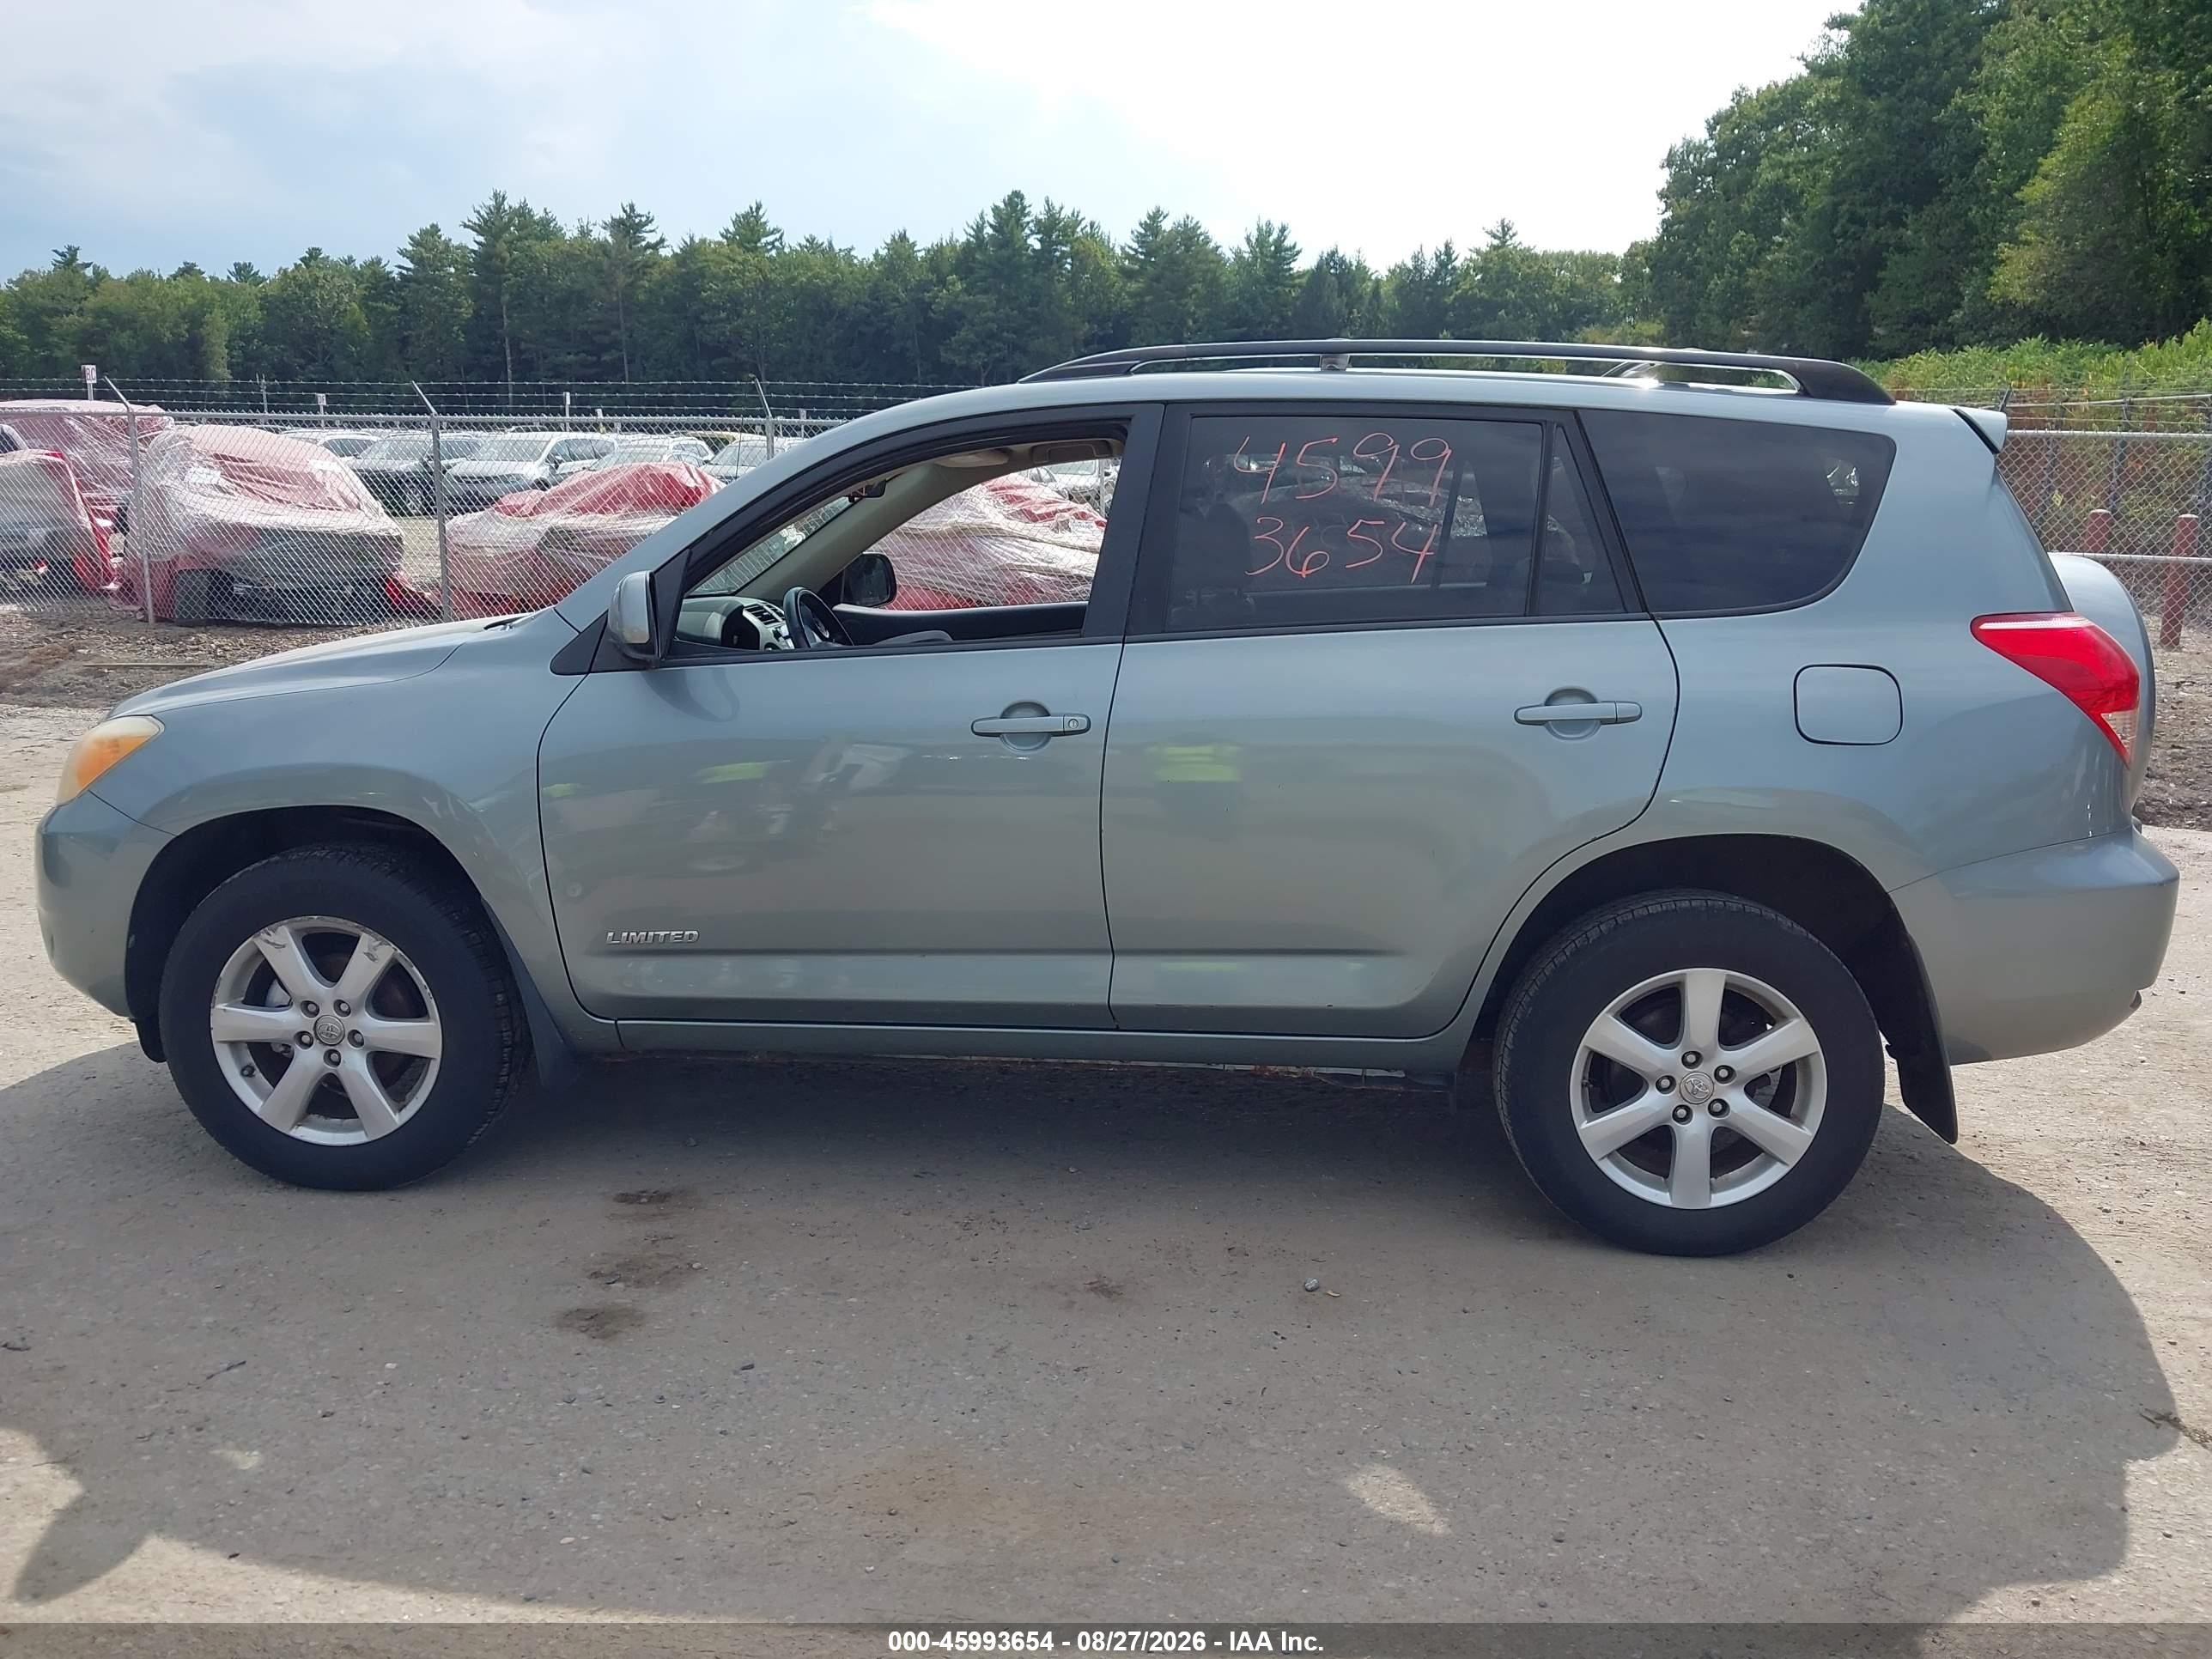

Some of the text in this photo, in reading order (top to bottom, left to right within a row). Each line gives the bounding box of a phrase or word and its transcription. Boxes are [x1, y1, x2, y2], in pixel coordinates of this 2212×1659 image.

[1234, 433, 1452, 507] 4599
[1245, 517, 1438, 584] 3654
[606, 930, 700, 945] LIMITED
